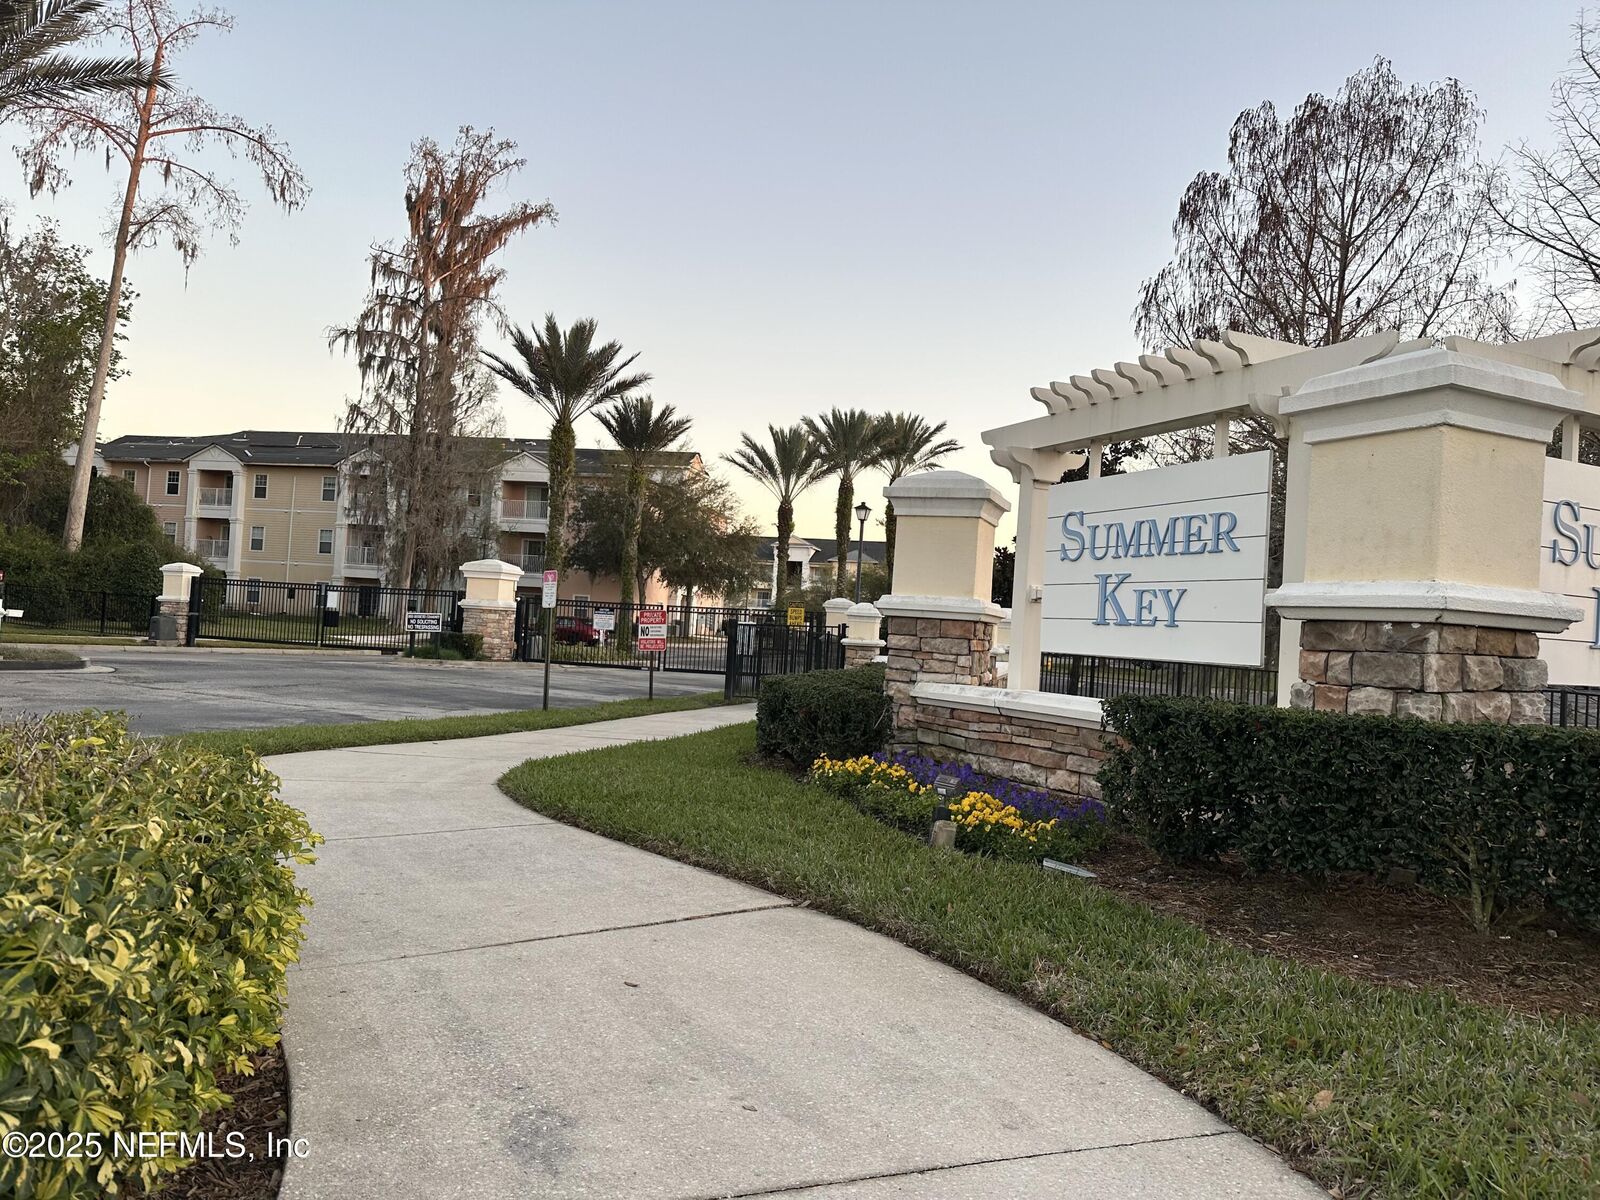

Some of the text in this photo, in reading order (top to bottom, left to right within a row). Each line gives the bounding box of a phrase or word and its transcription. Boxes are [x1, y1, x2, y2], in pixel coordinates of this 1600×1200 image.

[1060, 511, 1241, 562] SUMMER
[1092, 573, 1187, 627] KEY
[640, 626, 650, 636] NO
